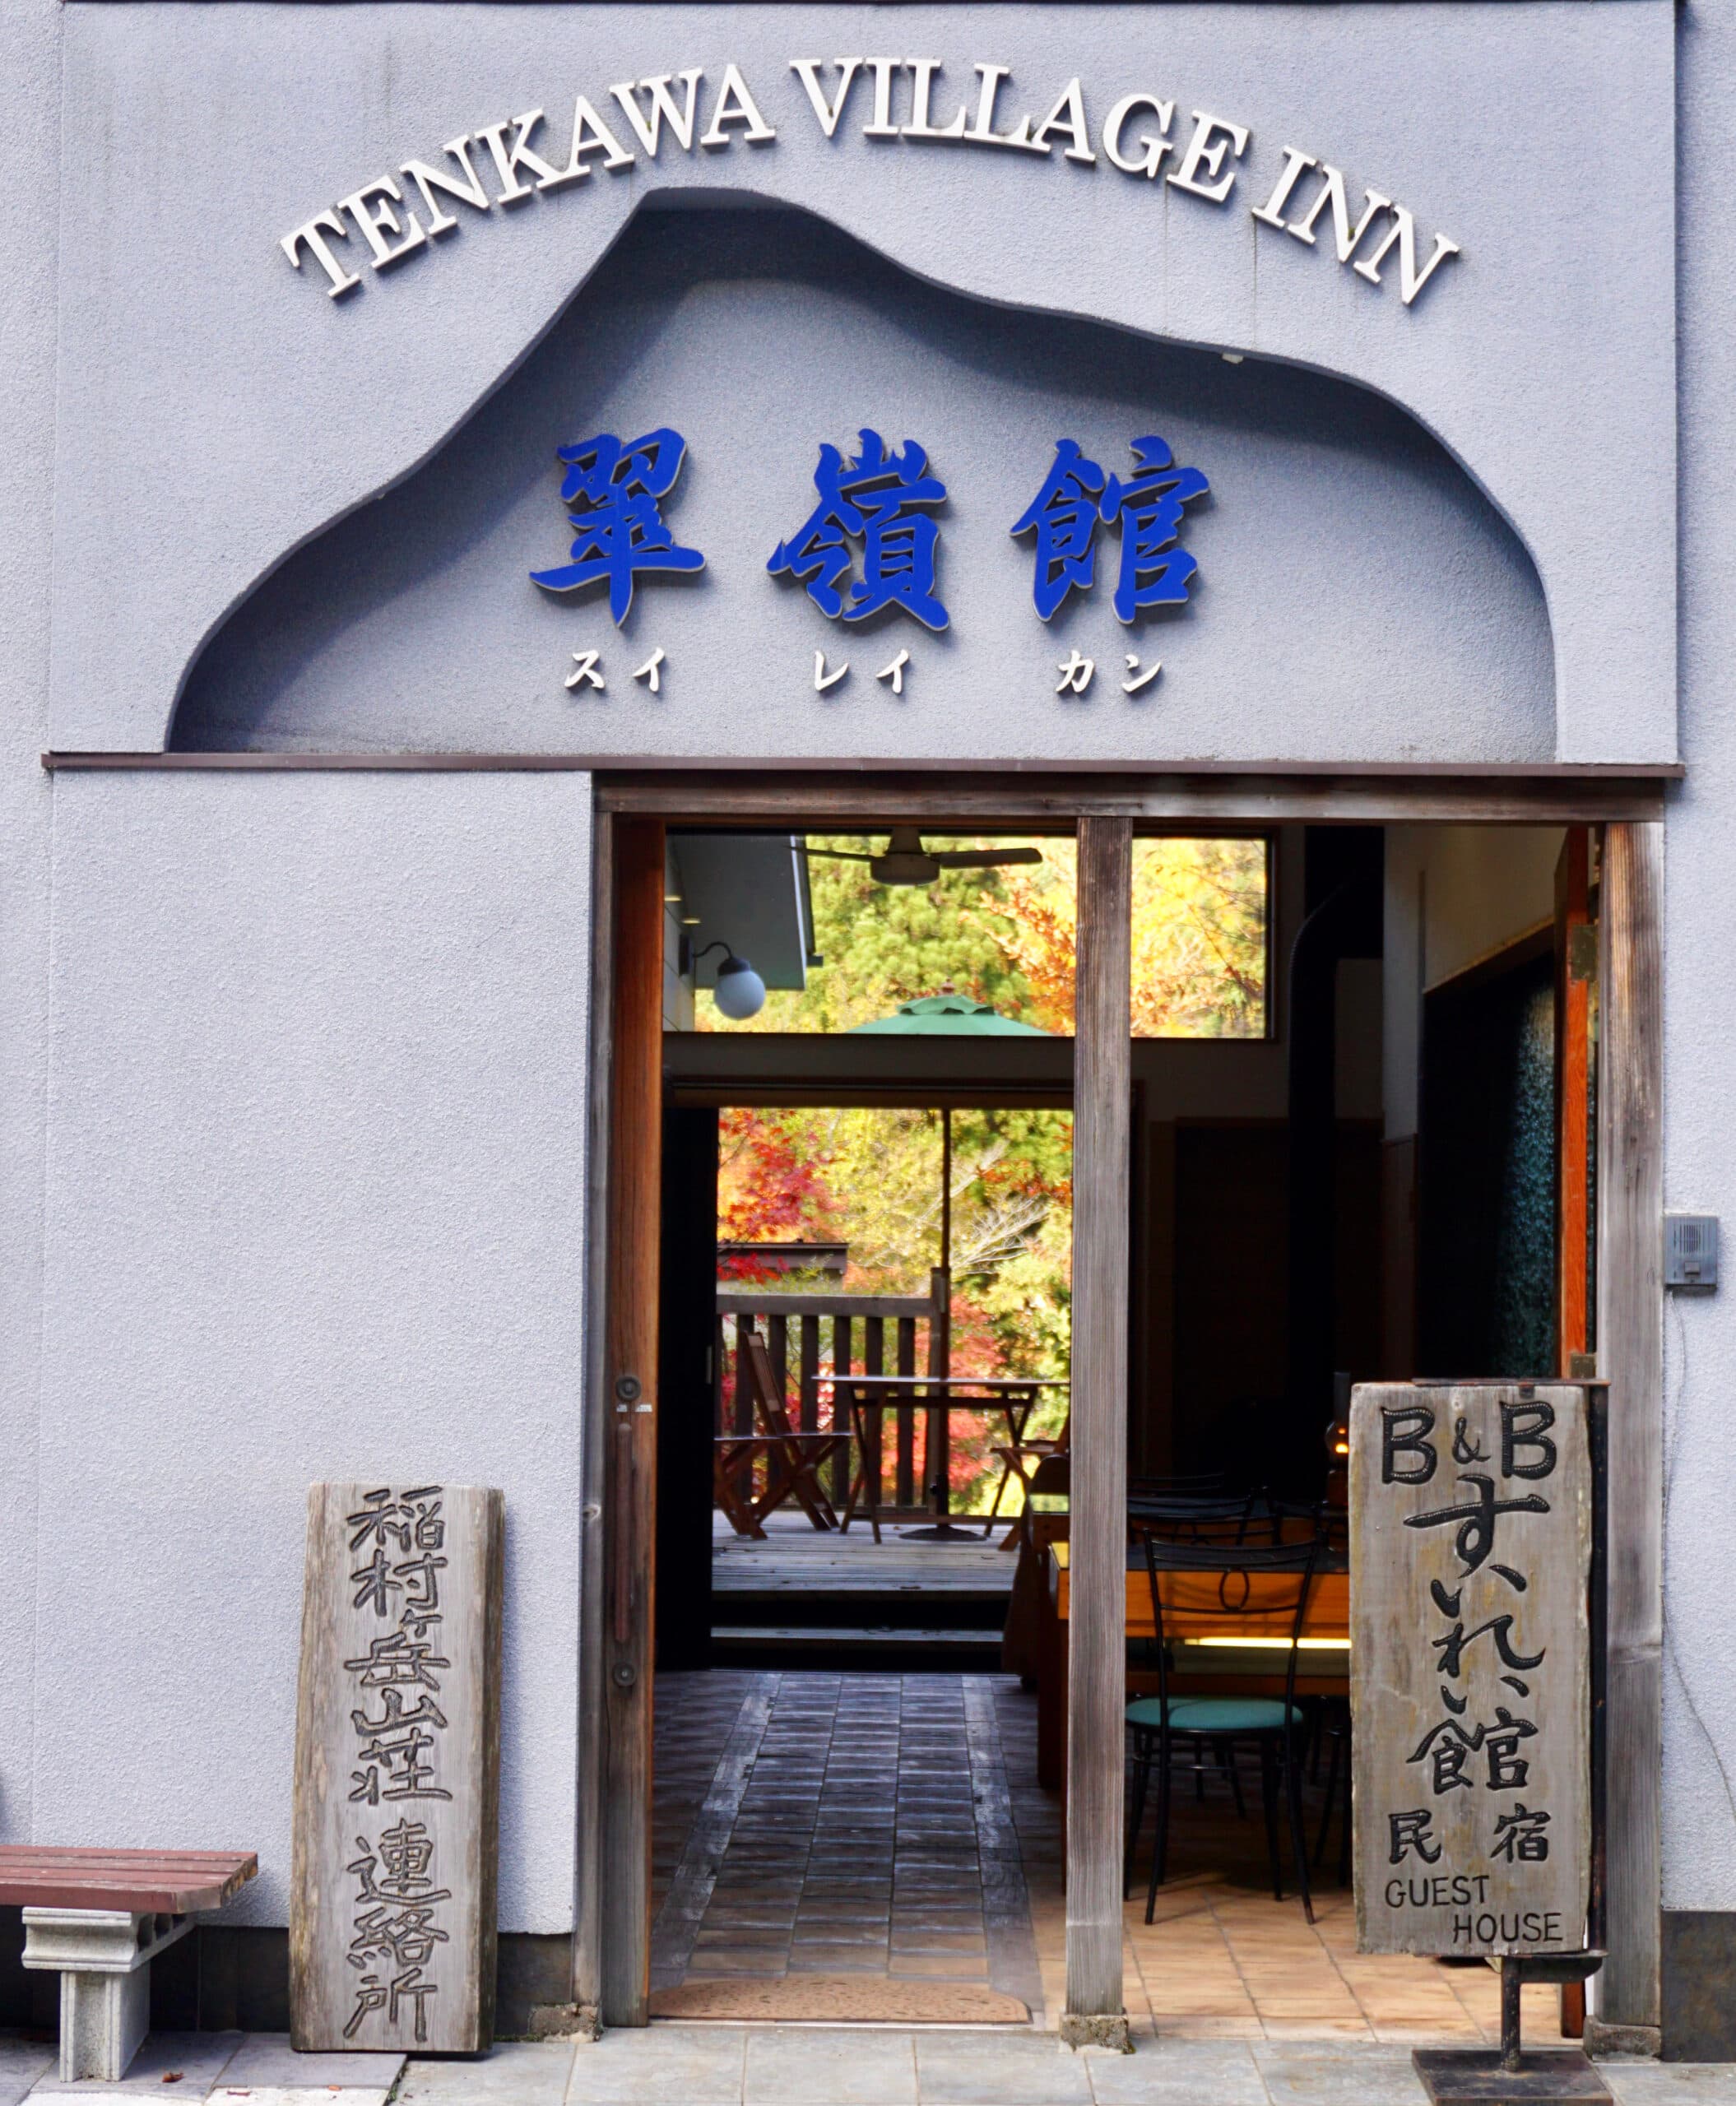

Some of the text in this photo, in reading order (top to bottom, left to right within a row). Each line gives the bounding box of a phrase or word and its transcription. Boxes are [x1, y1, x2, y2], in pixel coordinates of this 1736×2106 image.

[280, 57, 1460, 305] TENKAWA VILLAGE INN
[529, 427, 1211, 632] 翠嶺館
[1403, 1473, 1551, 1796] すいれい館
[1385, 1874, 1490, 1909] GUEST
[1453, 1912, 1563, 1944] HOUSE
